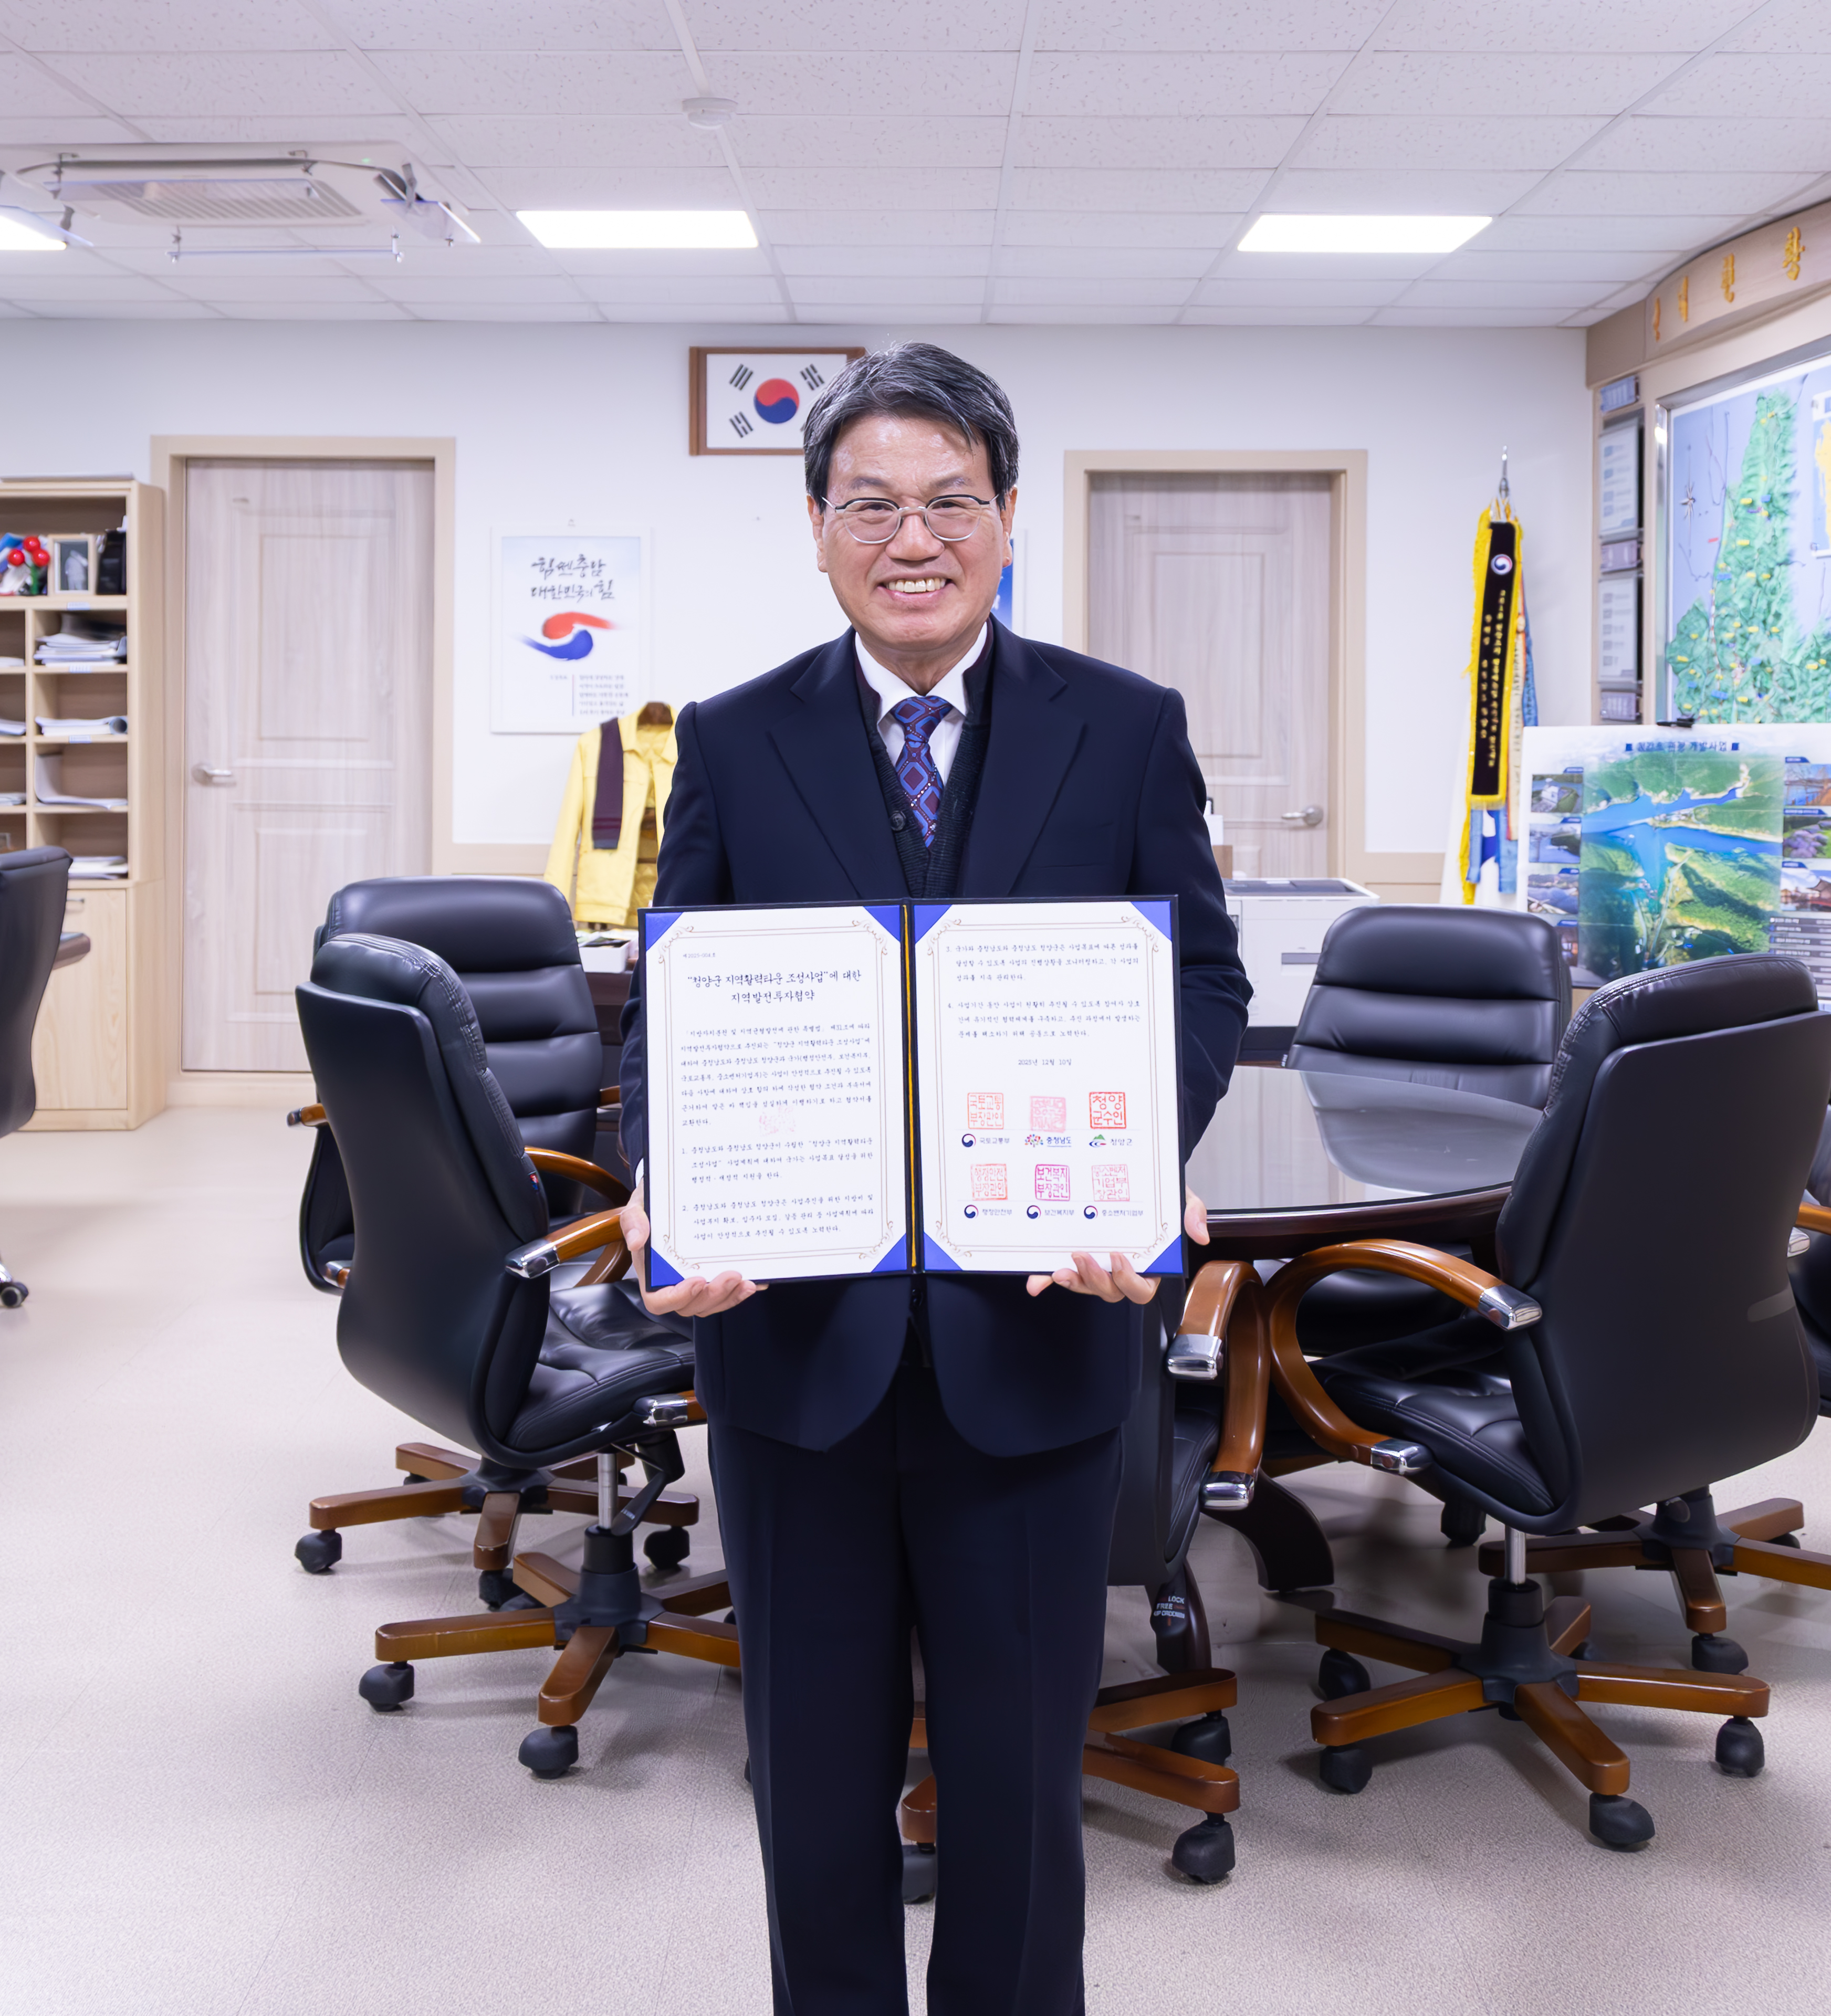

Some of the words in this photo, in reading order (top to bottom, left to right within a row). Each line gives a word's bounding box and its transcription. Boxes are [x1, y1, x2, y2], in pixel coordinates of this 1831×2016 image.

[593, 579, 615, 601] 힘
[725, 972, 783, 986] 지역활력타운
[842, 969, 861, 982] 대한
[731, 990, 815, 1004] 지역발전투자협약
[1092, 1094, 1123, 1110] 청양
[1093, 1110, 1123, 1126] 군수인
[1046, 1136, 1072, 1144] 충청남도
[1037, 1167, 1068, 1182] 보건복지
[1038, 1183, 1069, 1198] 부장관인
[1168, 1595, 1185, 1604] LOCK
